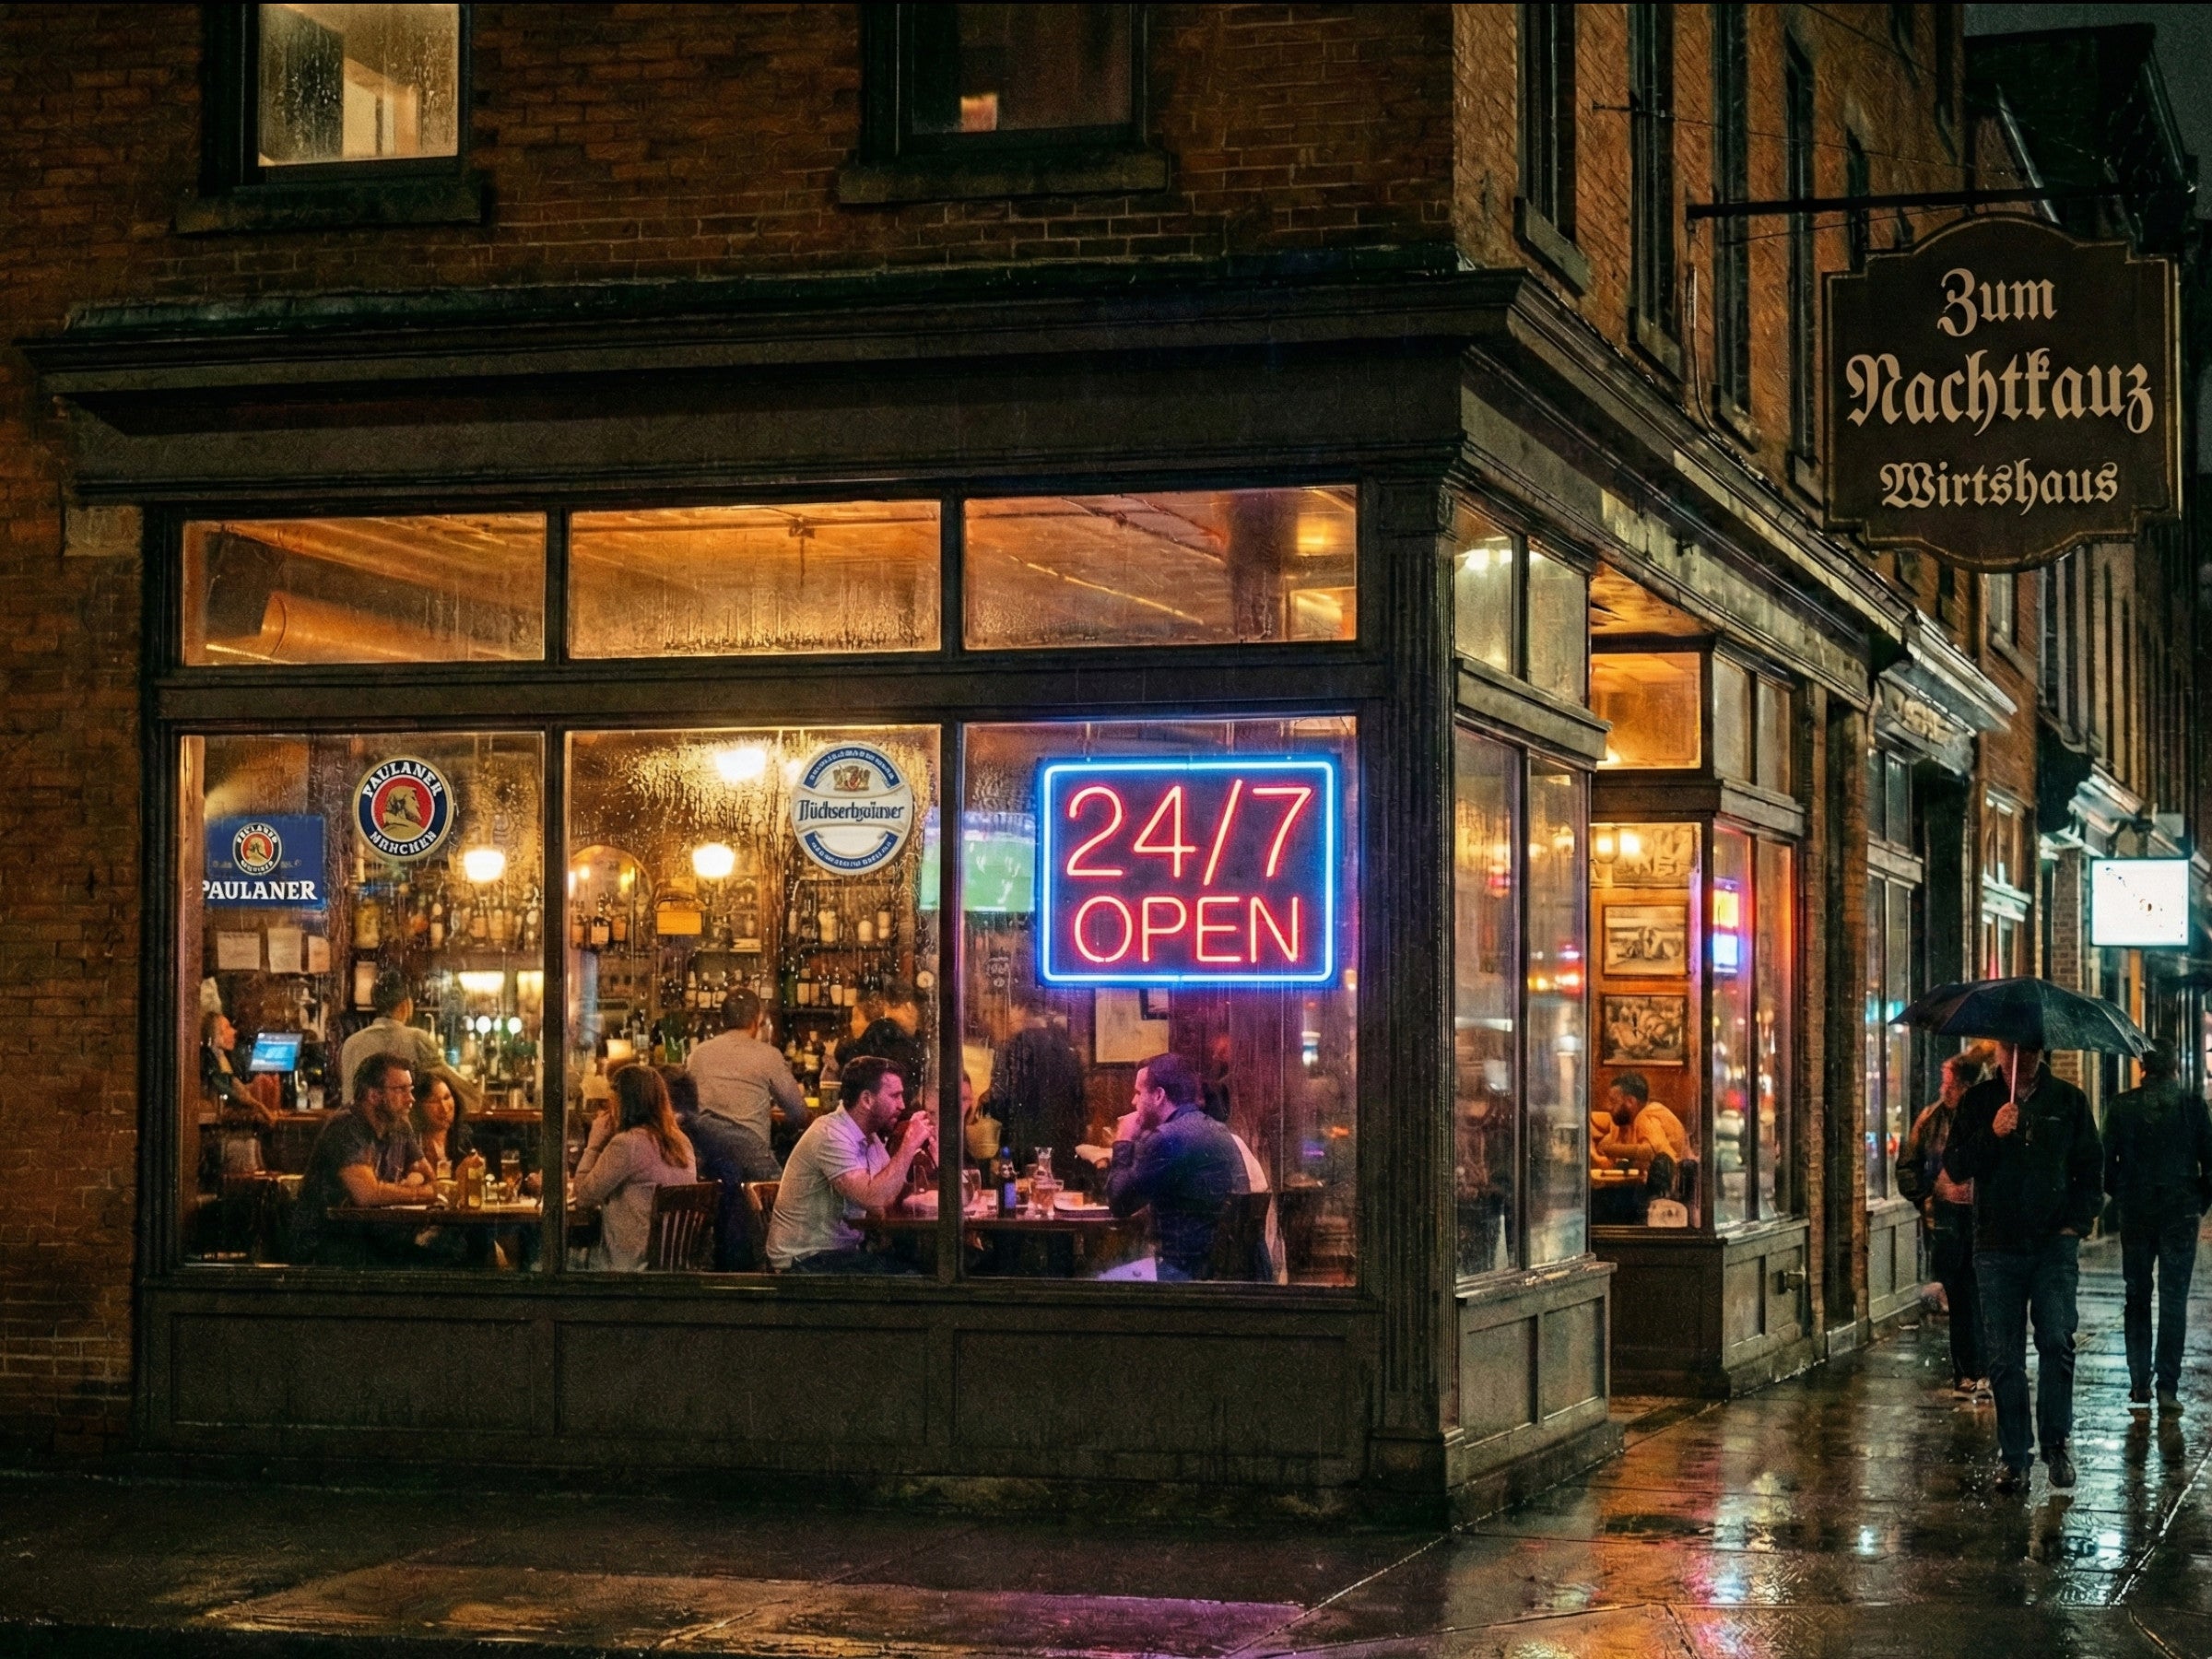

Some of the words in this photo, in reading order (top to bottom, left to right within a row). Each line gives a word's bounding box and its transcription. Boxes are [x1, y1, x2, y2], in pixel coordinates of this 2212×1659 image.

[1936, 267, 2058, 337] Zum
[1845, 347, 2154, 437] Nachtkauz
[1879, 457, 2119, 516] Wirtshaus
[362, 761, 442, 798] PAULANER
[1066, 778, 1312, 886] 24/7
[1074, 895, 1299, 963] OPEN
